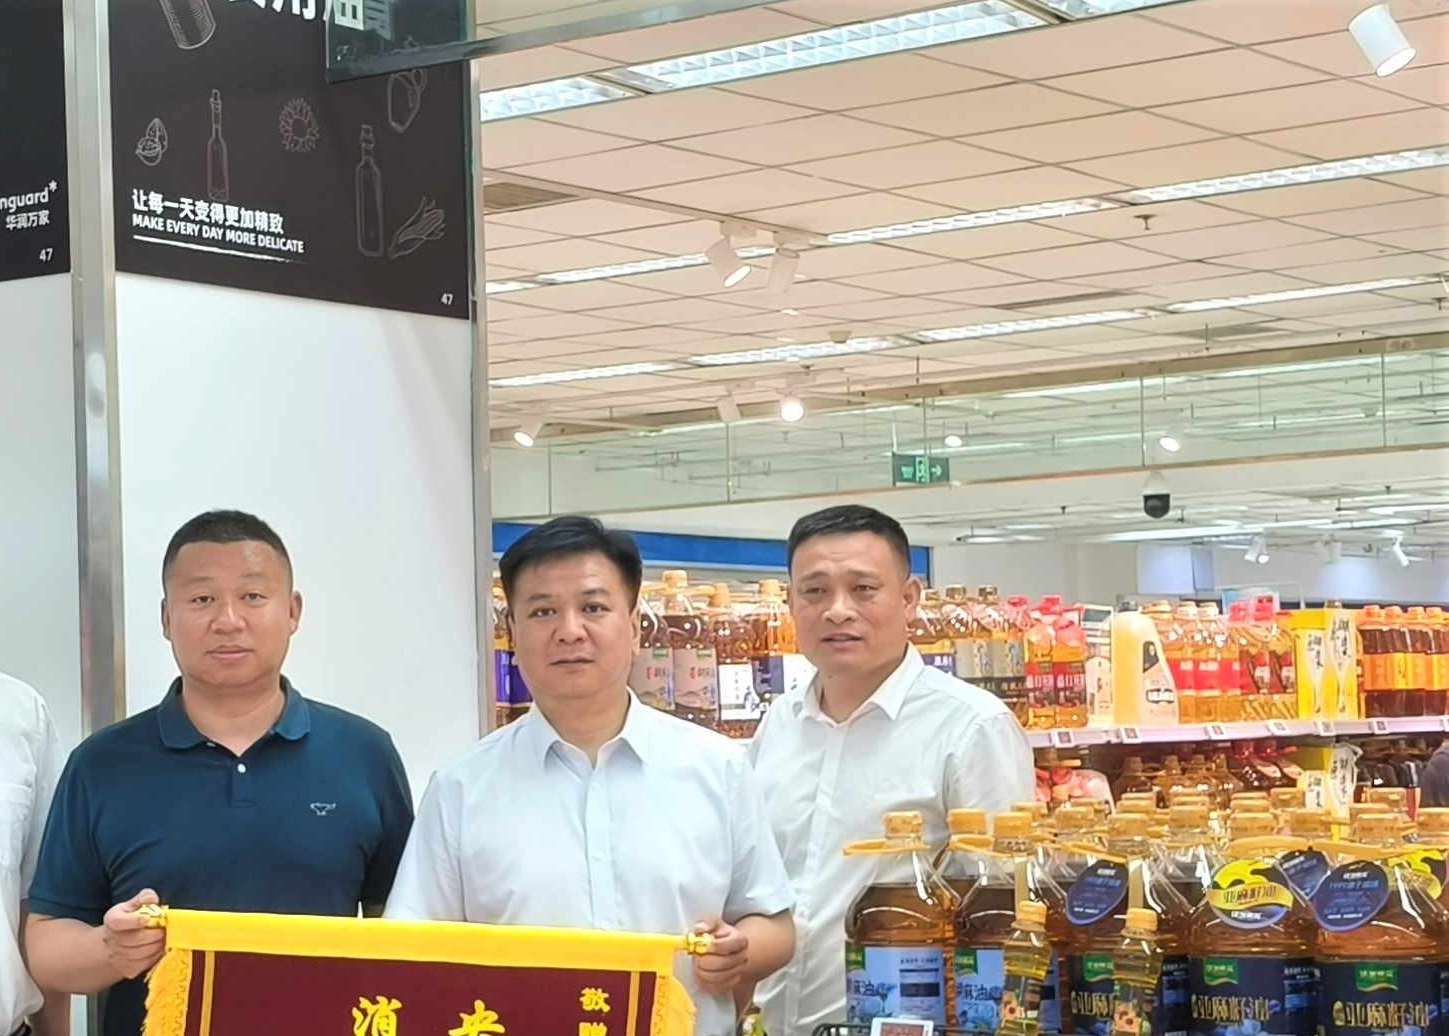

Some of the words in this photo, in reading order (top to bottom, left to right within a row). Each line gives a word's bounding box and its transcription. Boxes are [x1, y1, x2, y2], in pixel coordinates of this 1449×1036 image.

[5, 209, 50, 230] 华润万家
[132, 188, 284, 235] 让每一天变得更加精致
[132, 213, 164, 231] MAKE
[166, 217, 200, 237] EVERY
[201, 225, 224, 241] DAY
[225, 228, 256, 245] MORE
[257, 236, 305, 253] DELICATE
[39, 248, 53, 261] 47
[441, 293, 453, 305] 47
